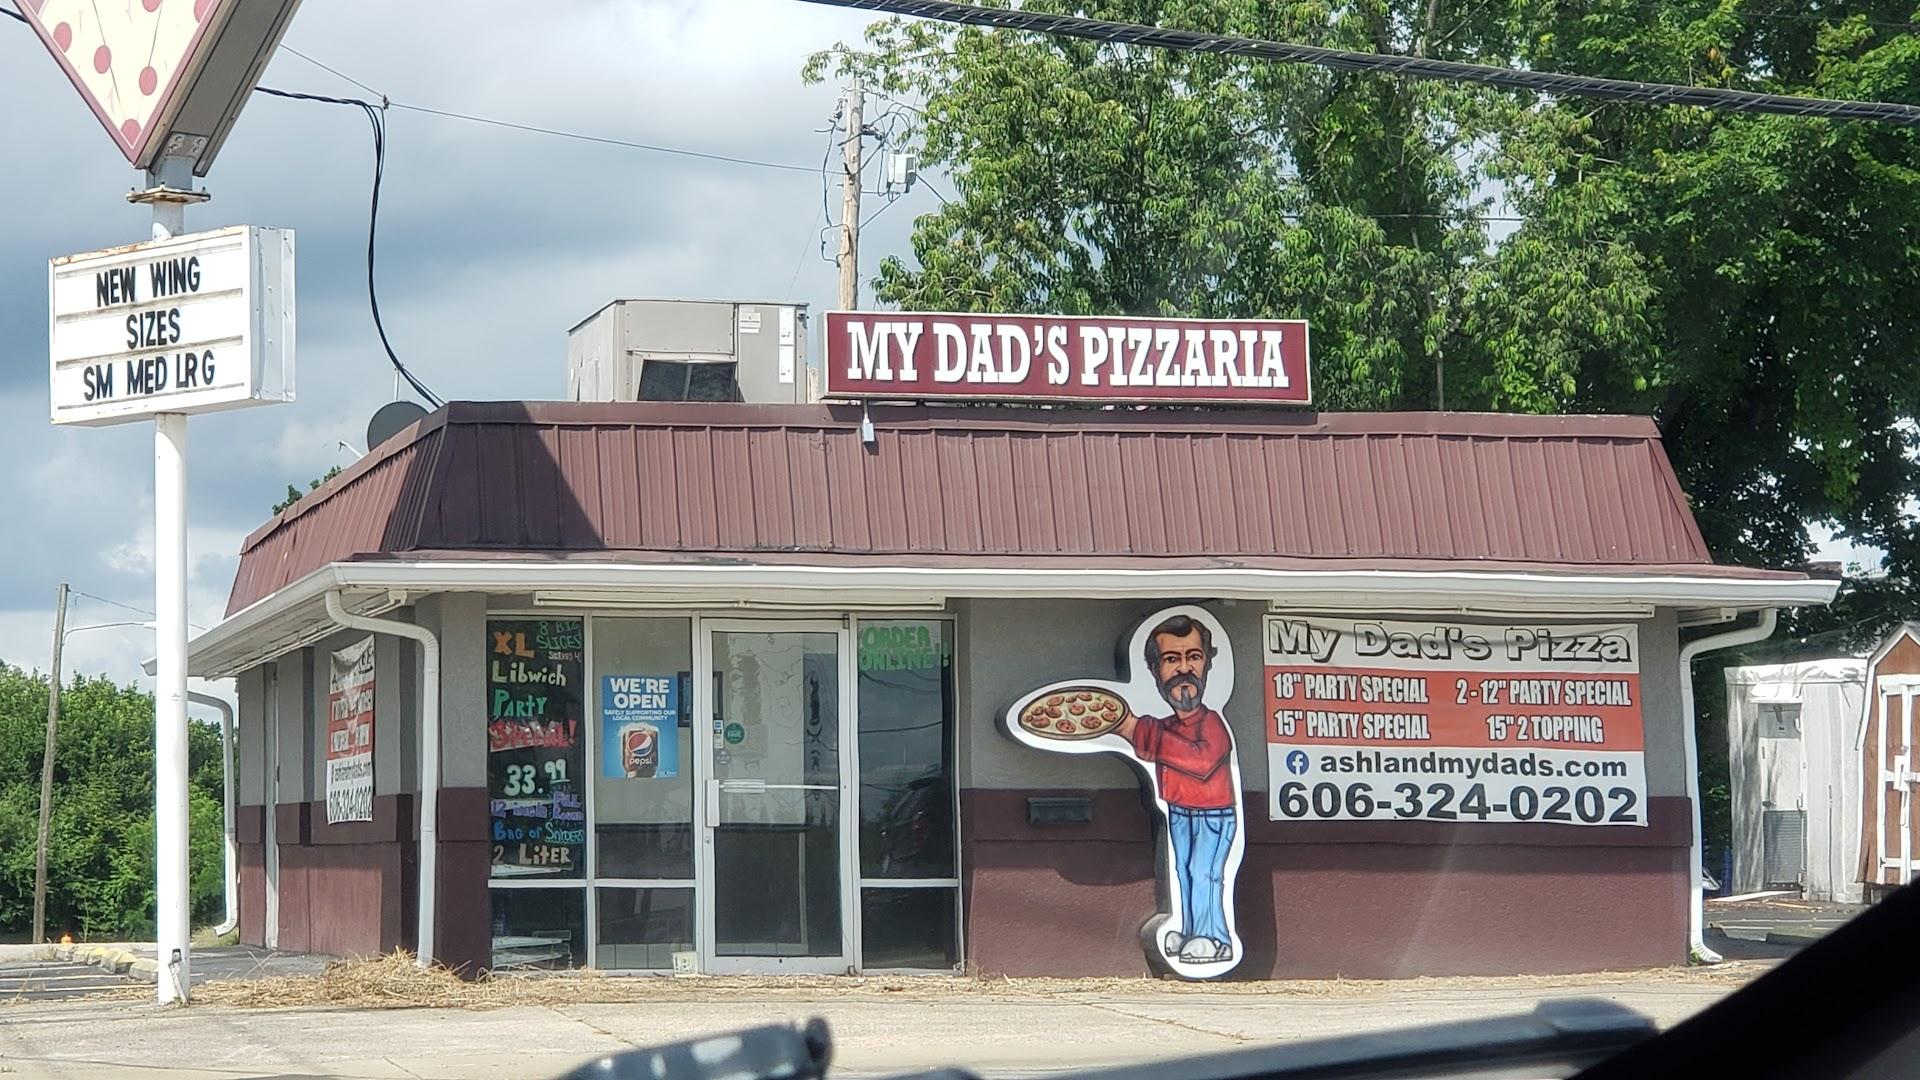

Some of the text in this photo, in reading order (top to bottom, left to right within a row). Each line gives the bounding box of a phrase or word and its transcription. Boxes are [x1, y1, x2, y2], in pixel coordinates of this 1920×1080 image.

[97, 256, 200, 307] NEW WING
[126, 308, 181, 350] SIZES
[847, 321, 923, 381] MY
[934, 323, 1070, 385] DAD'S
[1080, 326, 1289, 388] PIZZARIA
[83, 350, 215, 401] SM MED LRG
[536, 634, 582, 650] SLICES
[540, 621, 549, 636] 8
[861, 625, 932, 649] ORDER
[1269, 619, 1632, 662] My Dad's Pizza
[494, 631, 535, 658] XL
[492, 660, 566, 687] Libwich
[609, 678, 670, 694] WE'RE
[613, 693, 667, 709] OPEN
[1273, 673, 1430, 704] 18" PARTY SPECIAL
[1509, 679, 1562, 705] PARTY
[1564, 681, 1632, 707] SPECIAL
[1274, 710, 1431, 740] 15" PARTY SPECIAL
[1485, 715, 1605, 743] 15" 2 TOPPING
[629, 757, 653, 766] pepsi
[1320, 751, 1627, 779] ashlandmydads.com
[488, 799, 507, 818] 12
[1279, 781, 1638, 823] 606-324-0202
[492, 844, 505, 865] 2
